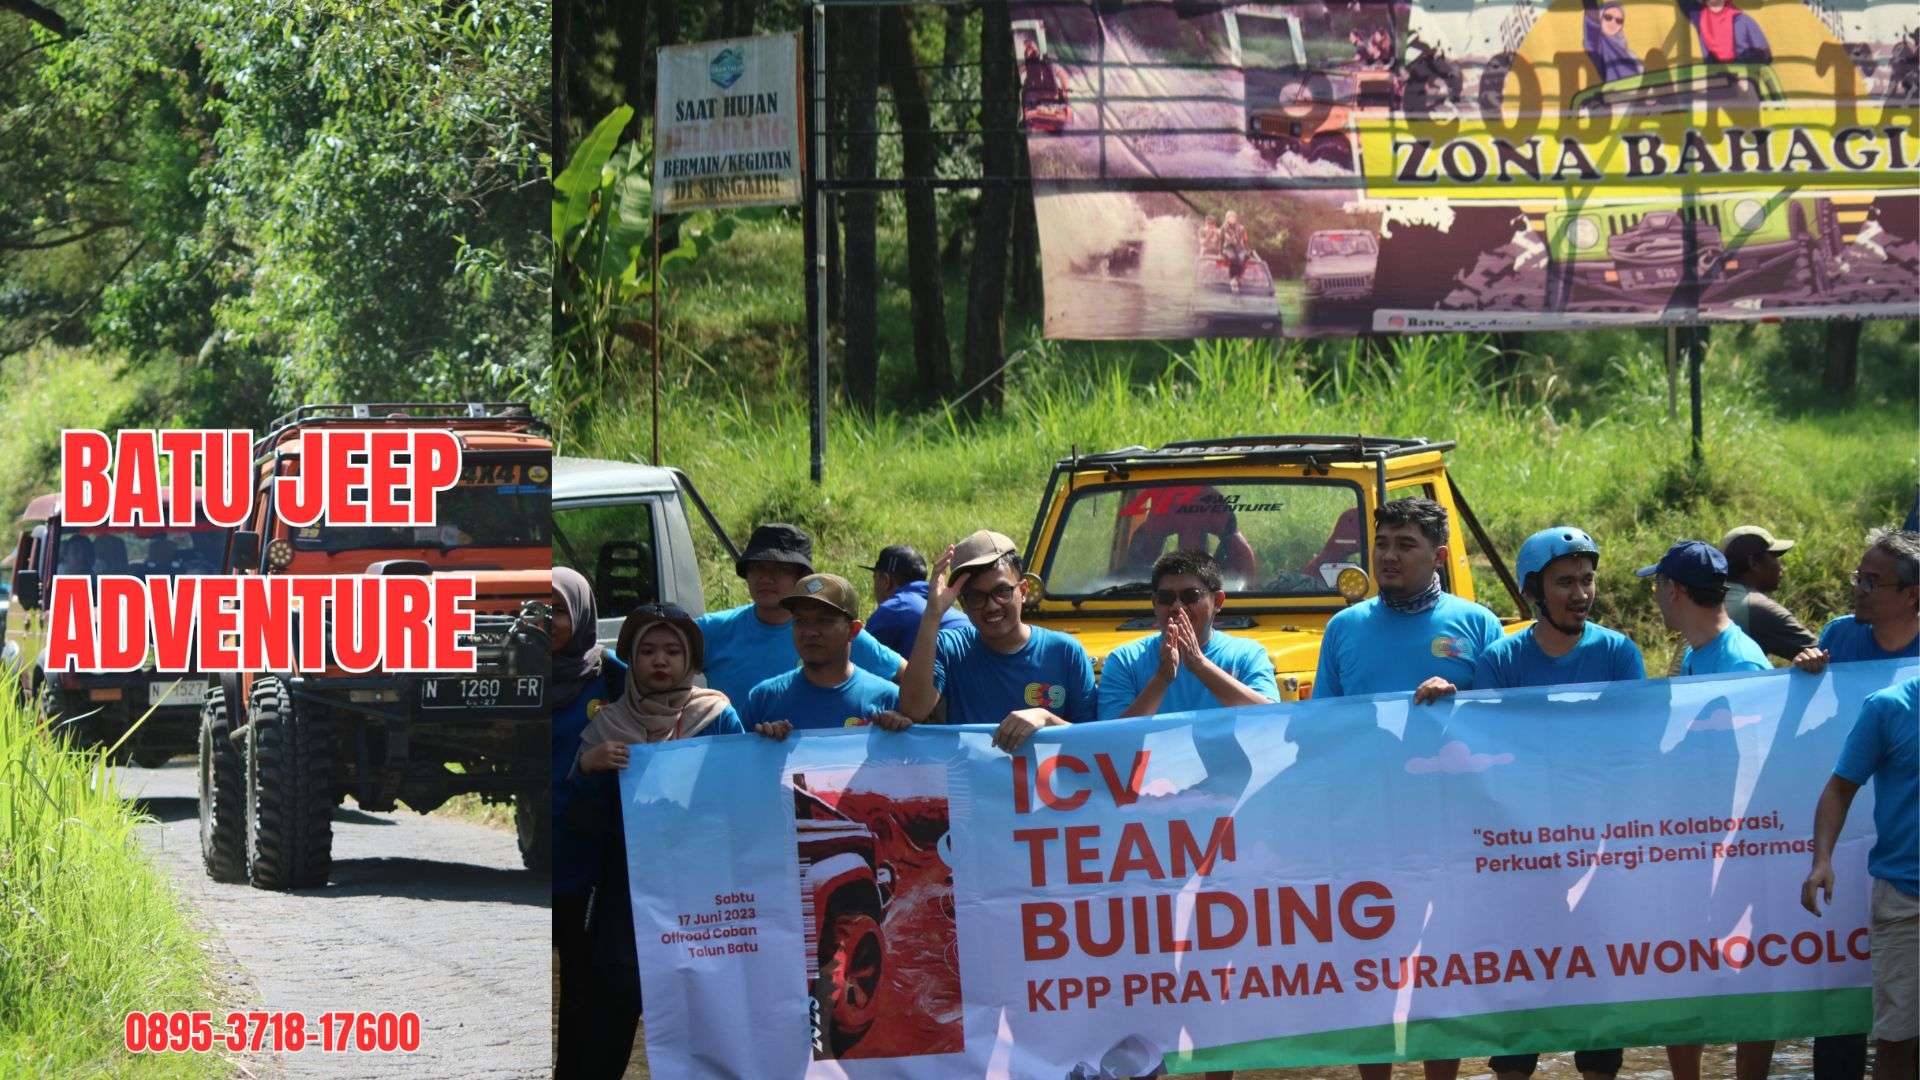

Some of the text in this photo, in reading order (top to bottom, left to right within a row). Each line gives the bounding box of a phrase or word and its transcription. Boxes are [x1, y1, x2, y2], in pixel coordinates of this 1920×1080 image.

[676, 92, 778, 122] SAAT HUJAN
[663, 151, 792, 178] BERMAIN/KEGIATAN
[1393, 125, 1919, 183] ZONA BAHAGI
[1177, 503, 1284, 513] ADVENTURE
[152, 684, 160, 697] N
[426, 678, 539, 698] N 1260 FR
[1012, 750, 1151, 815] ICV
[1538, 825, 1596, 845] Bahu
[1601, 820, 1655, 842] Jalin
[1659, 810, 1785, 837] Kolaborasi,
[1013, 816, 1237, 888] TEAM
[1475, 852, 1562, 874] Perkuat
[1566, 846, 1646, 870] Sinergi
[1649, 841, 1707, 863] Demi
[715, 892, 755, 905] Sabtu
[678, 908, 757, 926] 17 Juni 2023
[1021, 880, 1396, 962] BUILDING
[661, 925, 757, 945] Offroad Coban
[688, 942, 758, 959] Talun Batu
[1027, 976, 1111, 1013] KPP
[1123, 961, 1344, 1007] PRATAMA
[1353, 945, 1596, 993] SURABAYA
